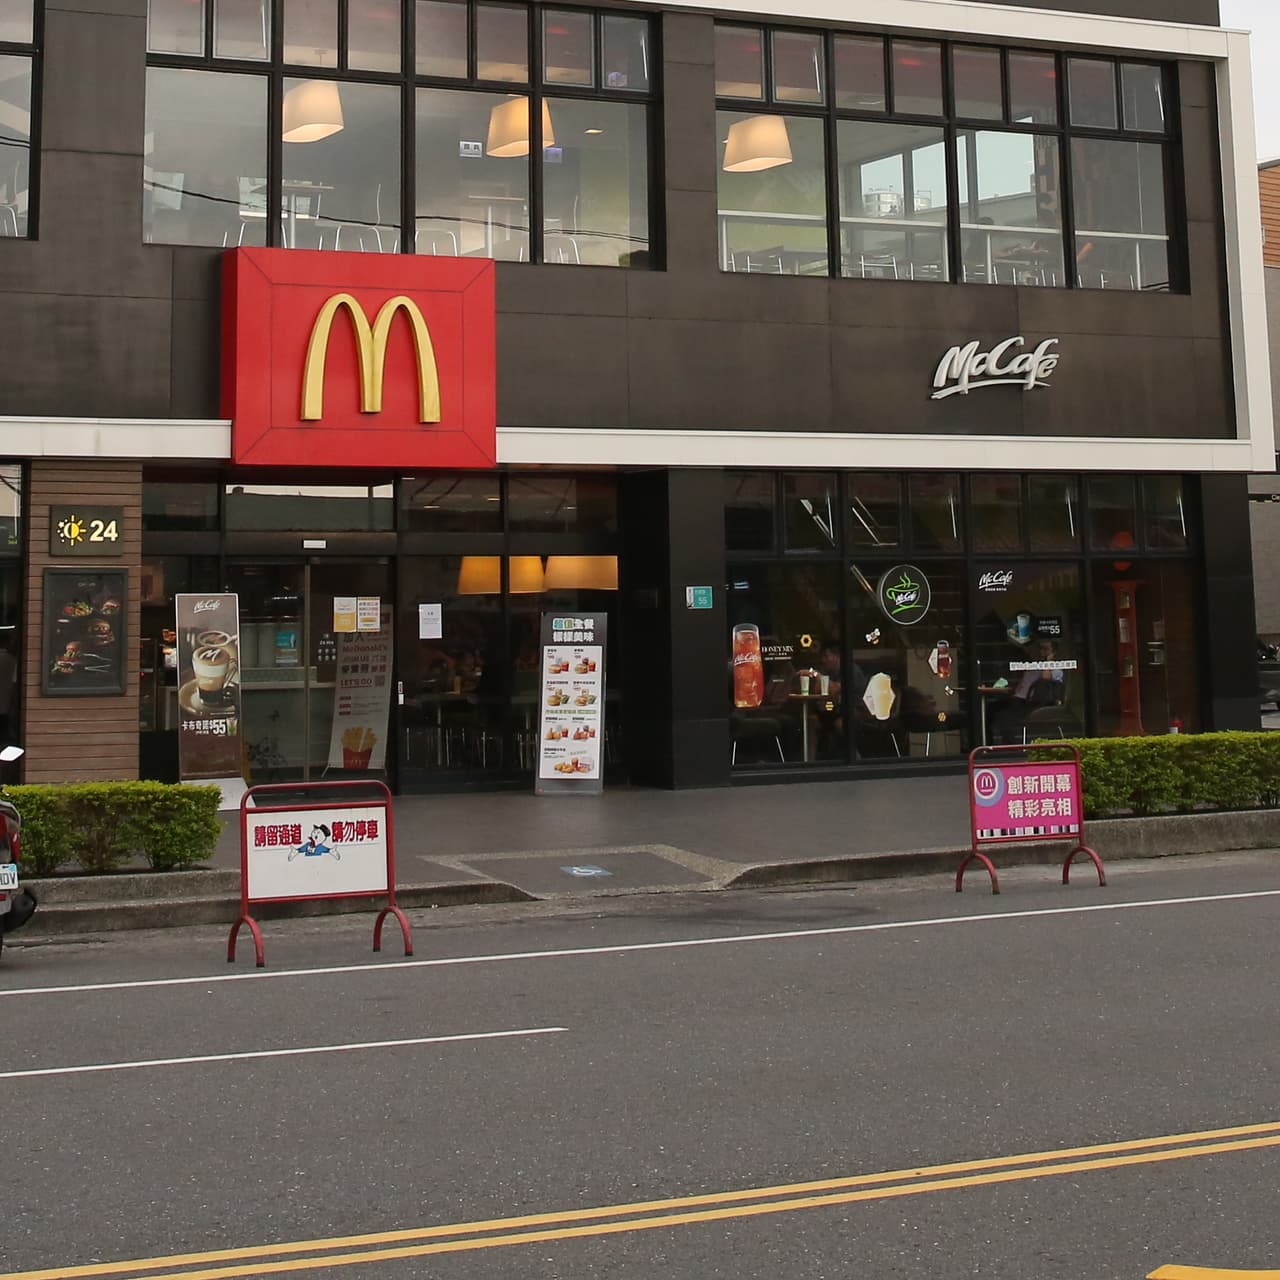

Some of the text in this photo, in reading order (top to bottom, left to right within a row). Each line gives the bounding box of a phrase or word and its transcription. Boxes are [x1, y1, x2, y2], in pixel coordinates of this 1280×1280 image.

[89, 519, 119, 542] 24
[1007, 774, 1071, 795] 創新開幕
[1007, 798, 1072, 819] 精彩亮相
[254, 820, 379, 848] 請留通道 請勿停車
